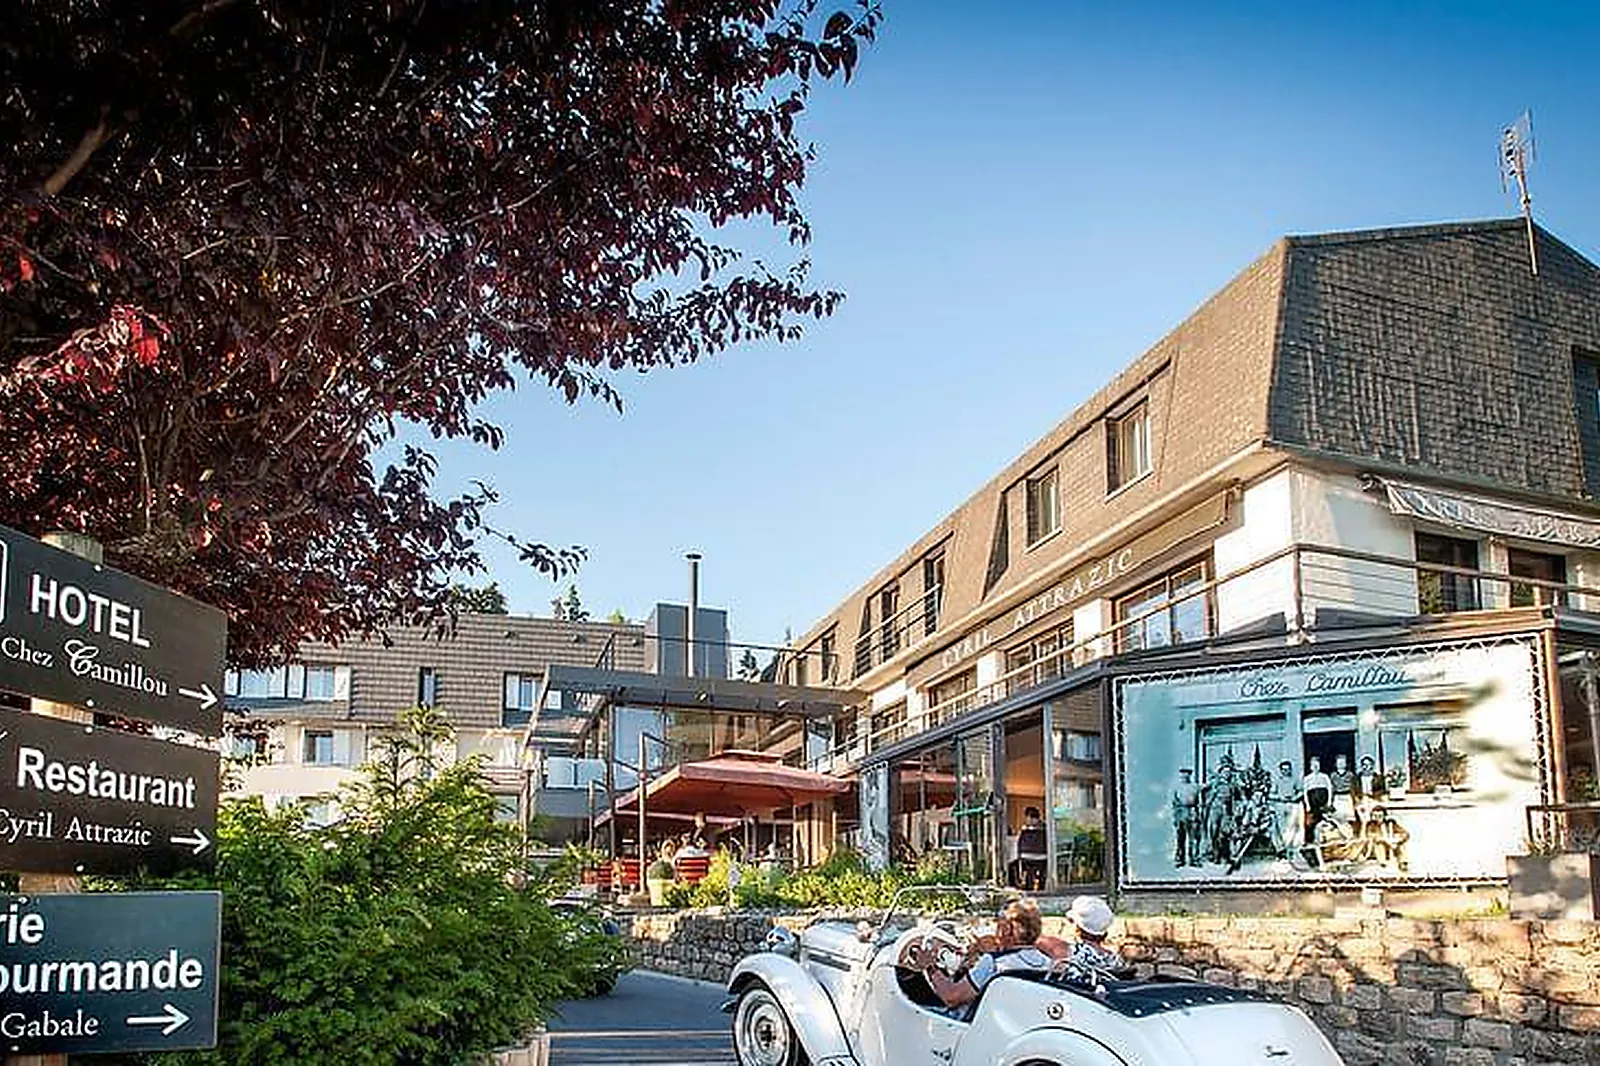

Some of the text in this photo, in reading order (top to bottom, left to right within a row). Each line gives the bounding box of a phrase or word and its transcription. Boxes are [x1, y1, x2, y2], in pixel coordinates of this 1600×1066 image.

[30, 573, 151, 648] HOTEL
[1012, 549, 1134, 630] ATTRAZIC
[1, 637, 168, 696] Chez Camillou
[17, 747, 196, 809] Restaurant
[0, 808, 151, 846] Cyril Attrazic
[1, 1008, 99, 1038] Gabale
